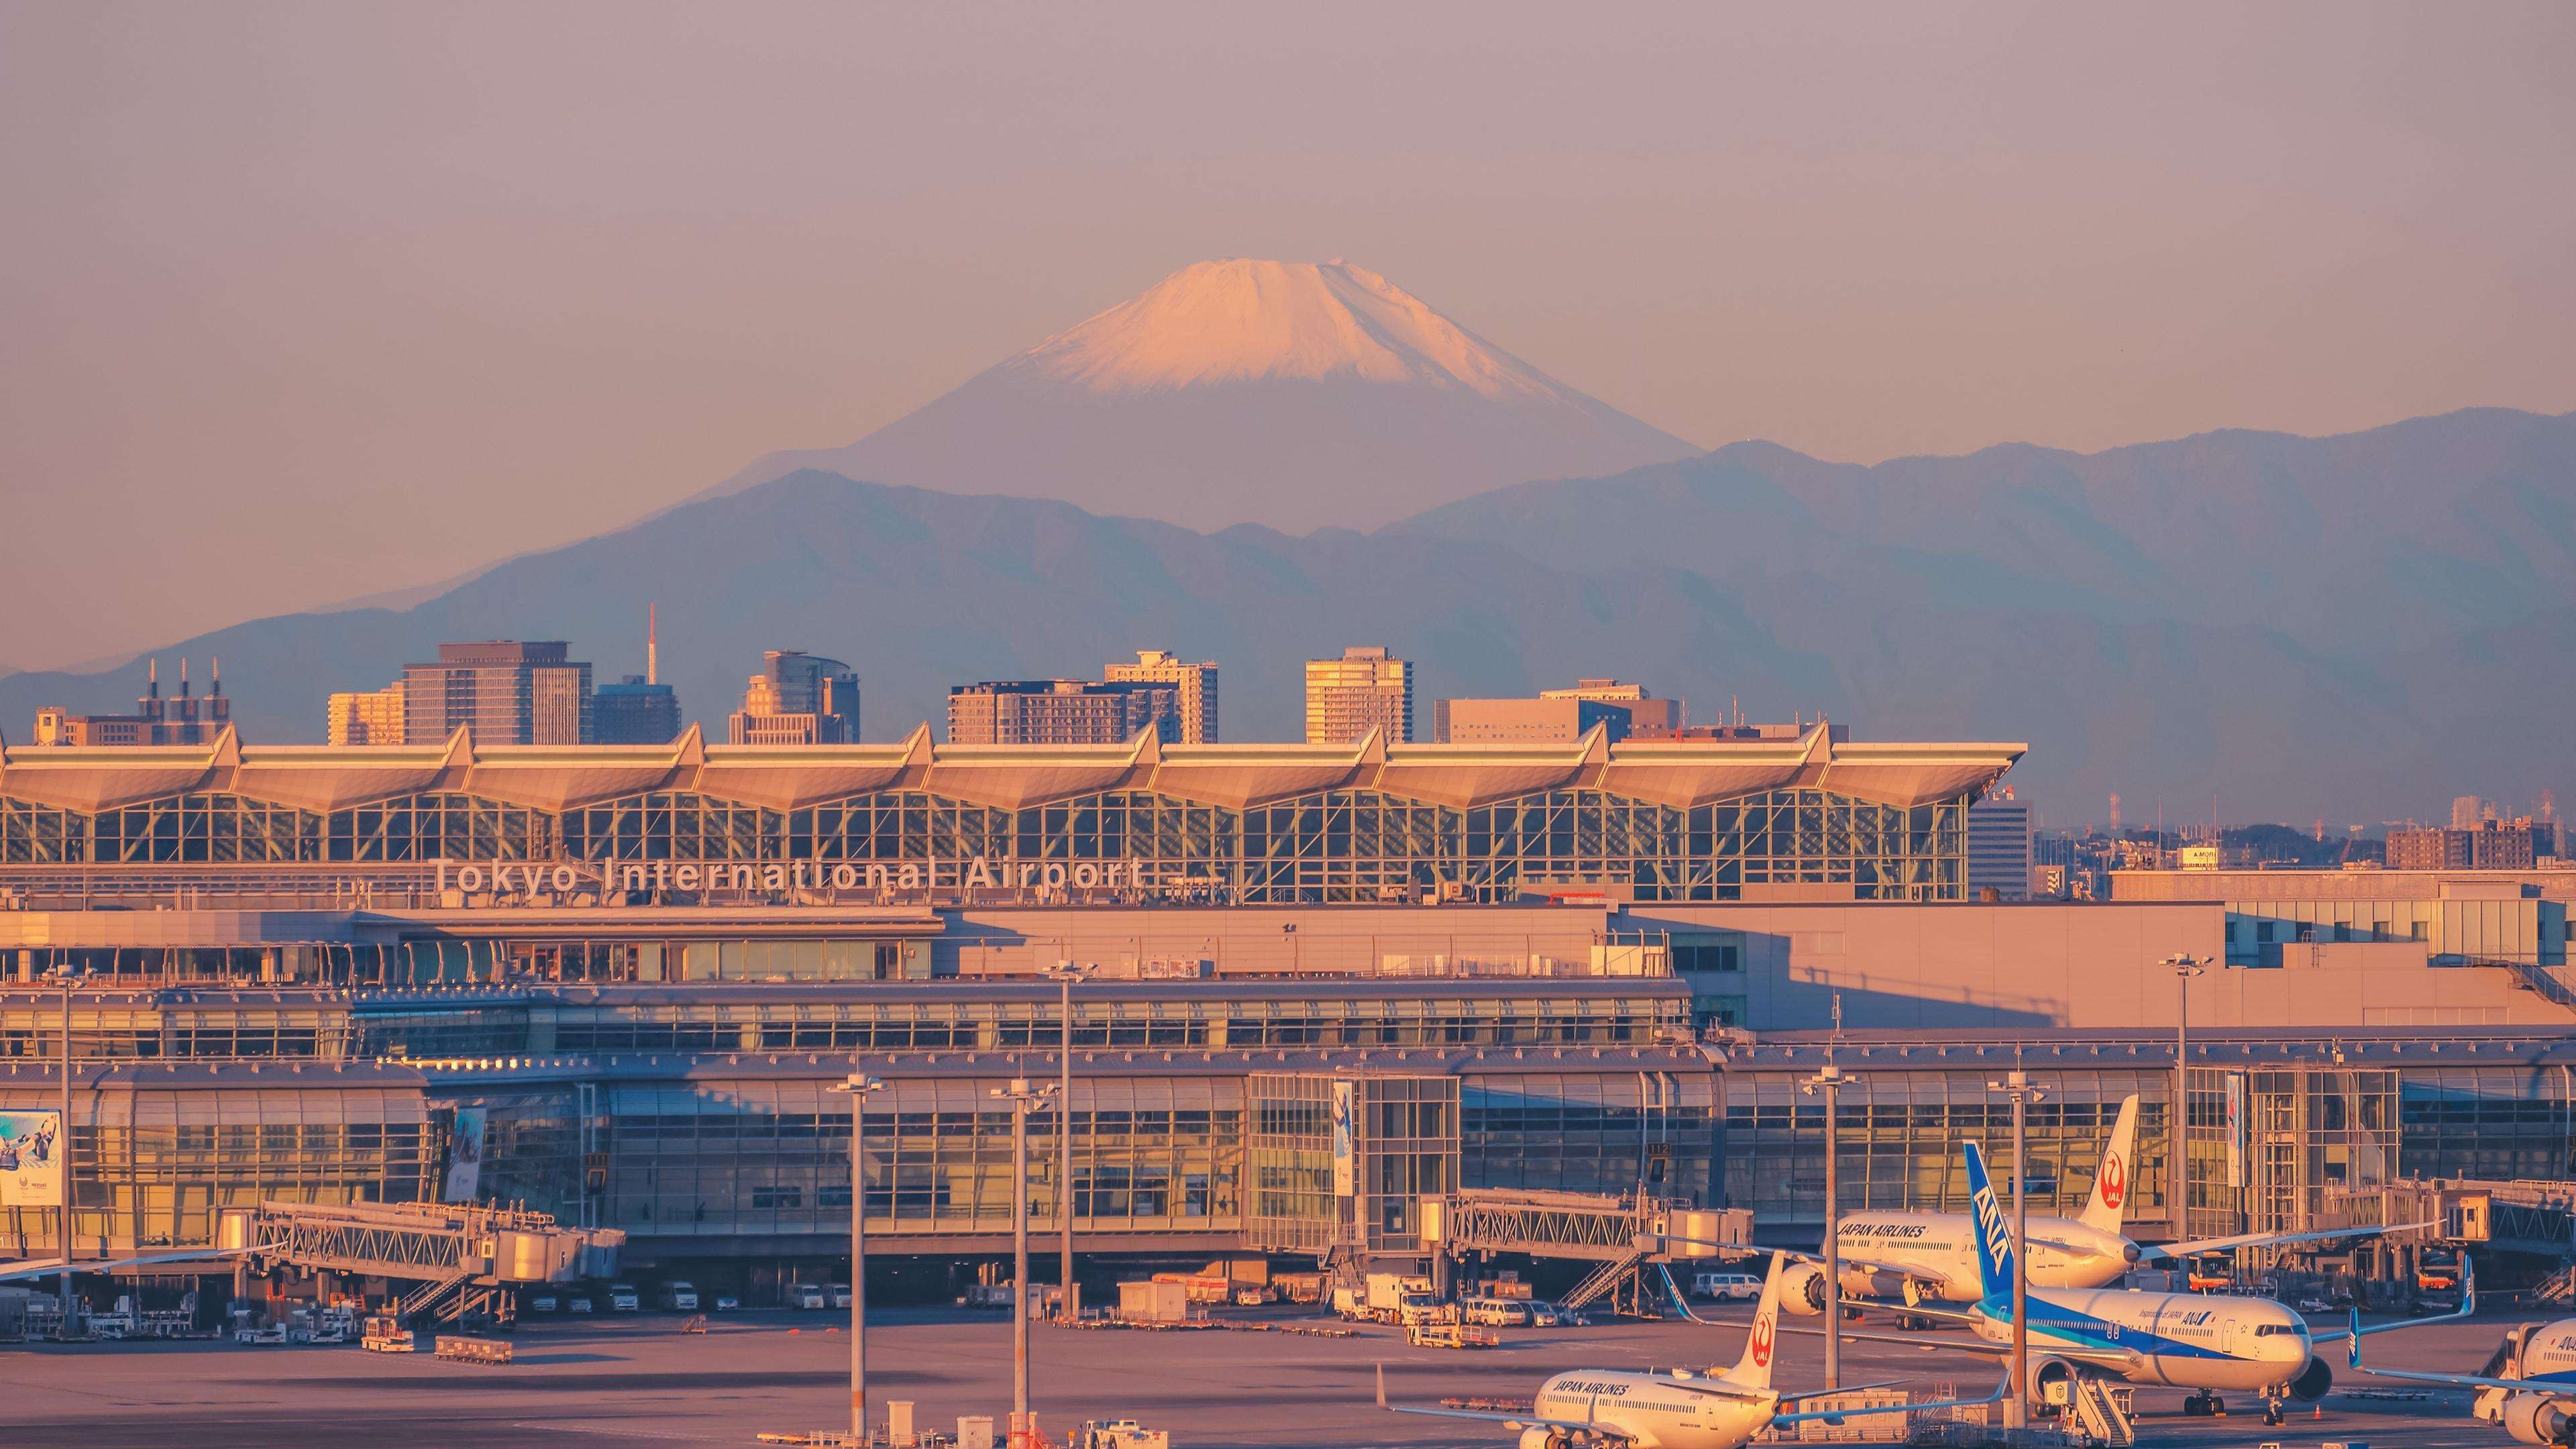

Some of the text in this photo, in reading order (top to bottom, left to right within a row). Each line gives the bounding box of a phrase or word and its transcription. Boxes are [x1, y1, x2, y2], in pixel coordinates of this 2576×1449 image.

[427, 855, 1146, 901] Tokyo International Airport
[2106, 1191, 2121, 1202] JAL
[1837, 1224, 1926, 1238] JAPAN AIRLINES
[1974, 1185, 2008, 1277] ANA
[2181, 1311, 2202, 1326] ANA
[1756, 1351, 1768, 1361] JAL
[1553, 1380, 1629, 1396] JAPAN AIRLINES
